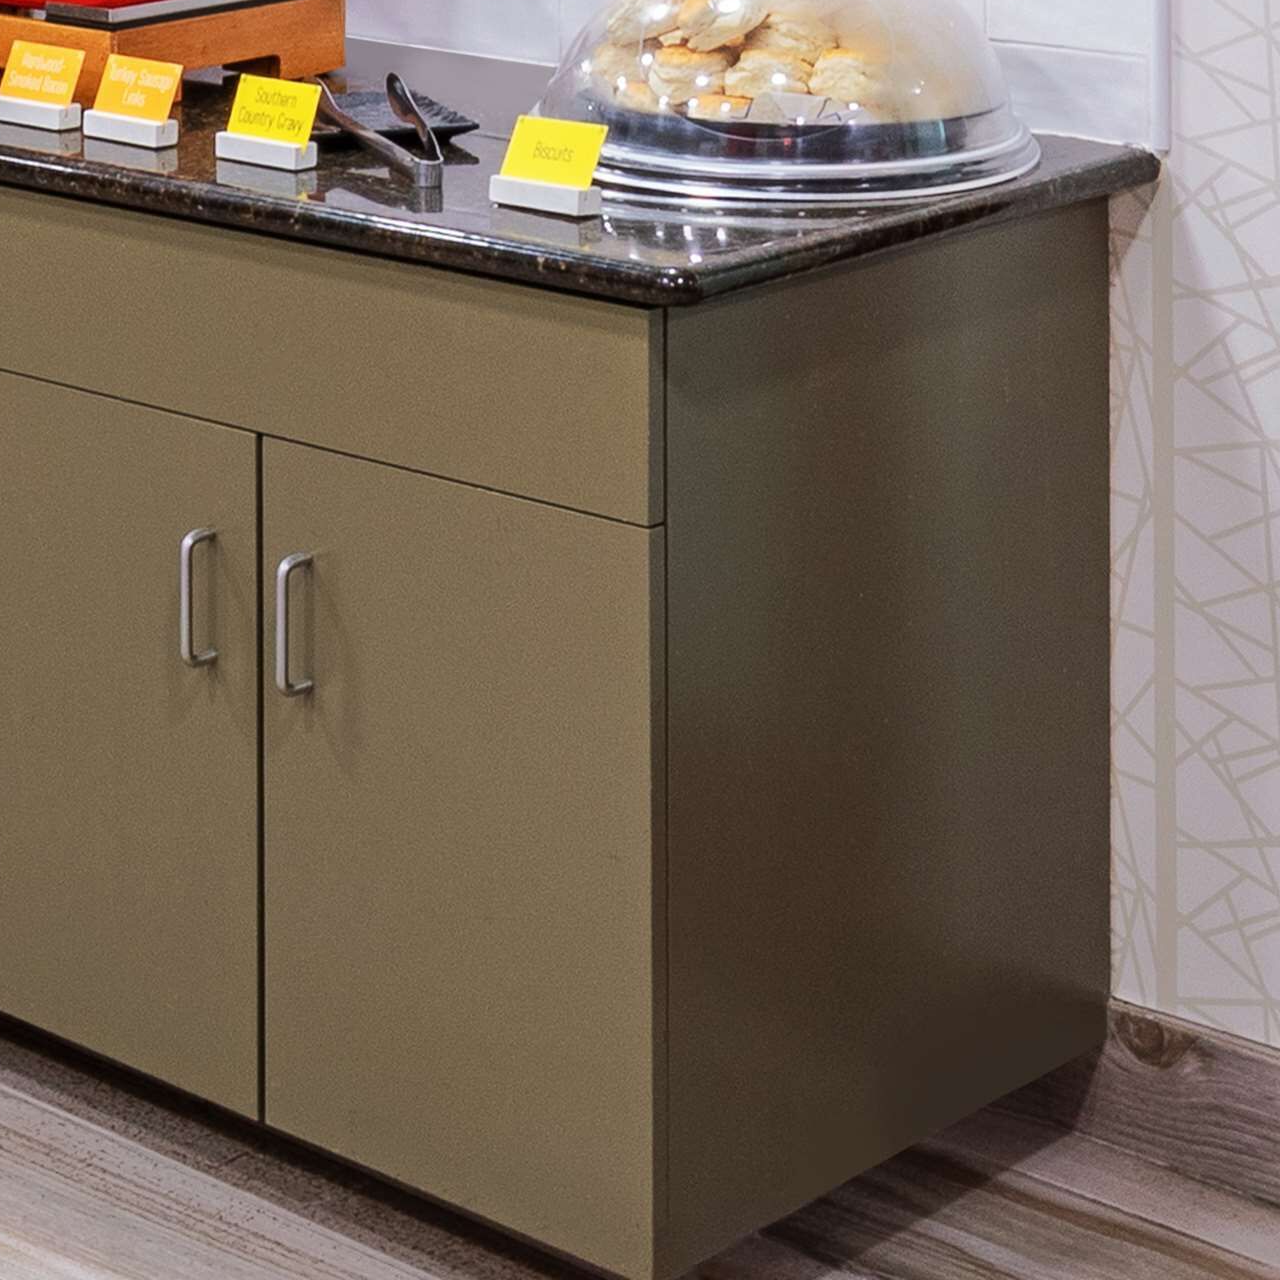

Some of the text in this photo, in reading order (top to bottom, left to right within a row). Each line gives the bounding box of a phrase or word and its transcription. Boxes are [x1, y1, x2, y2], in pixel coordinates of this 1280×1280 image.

[256, 86, 297, 107] Southern
[238, 106, 305, 137] Country Gravy
[533, 140, 575, 163] Biscuits
